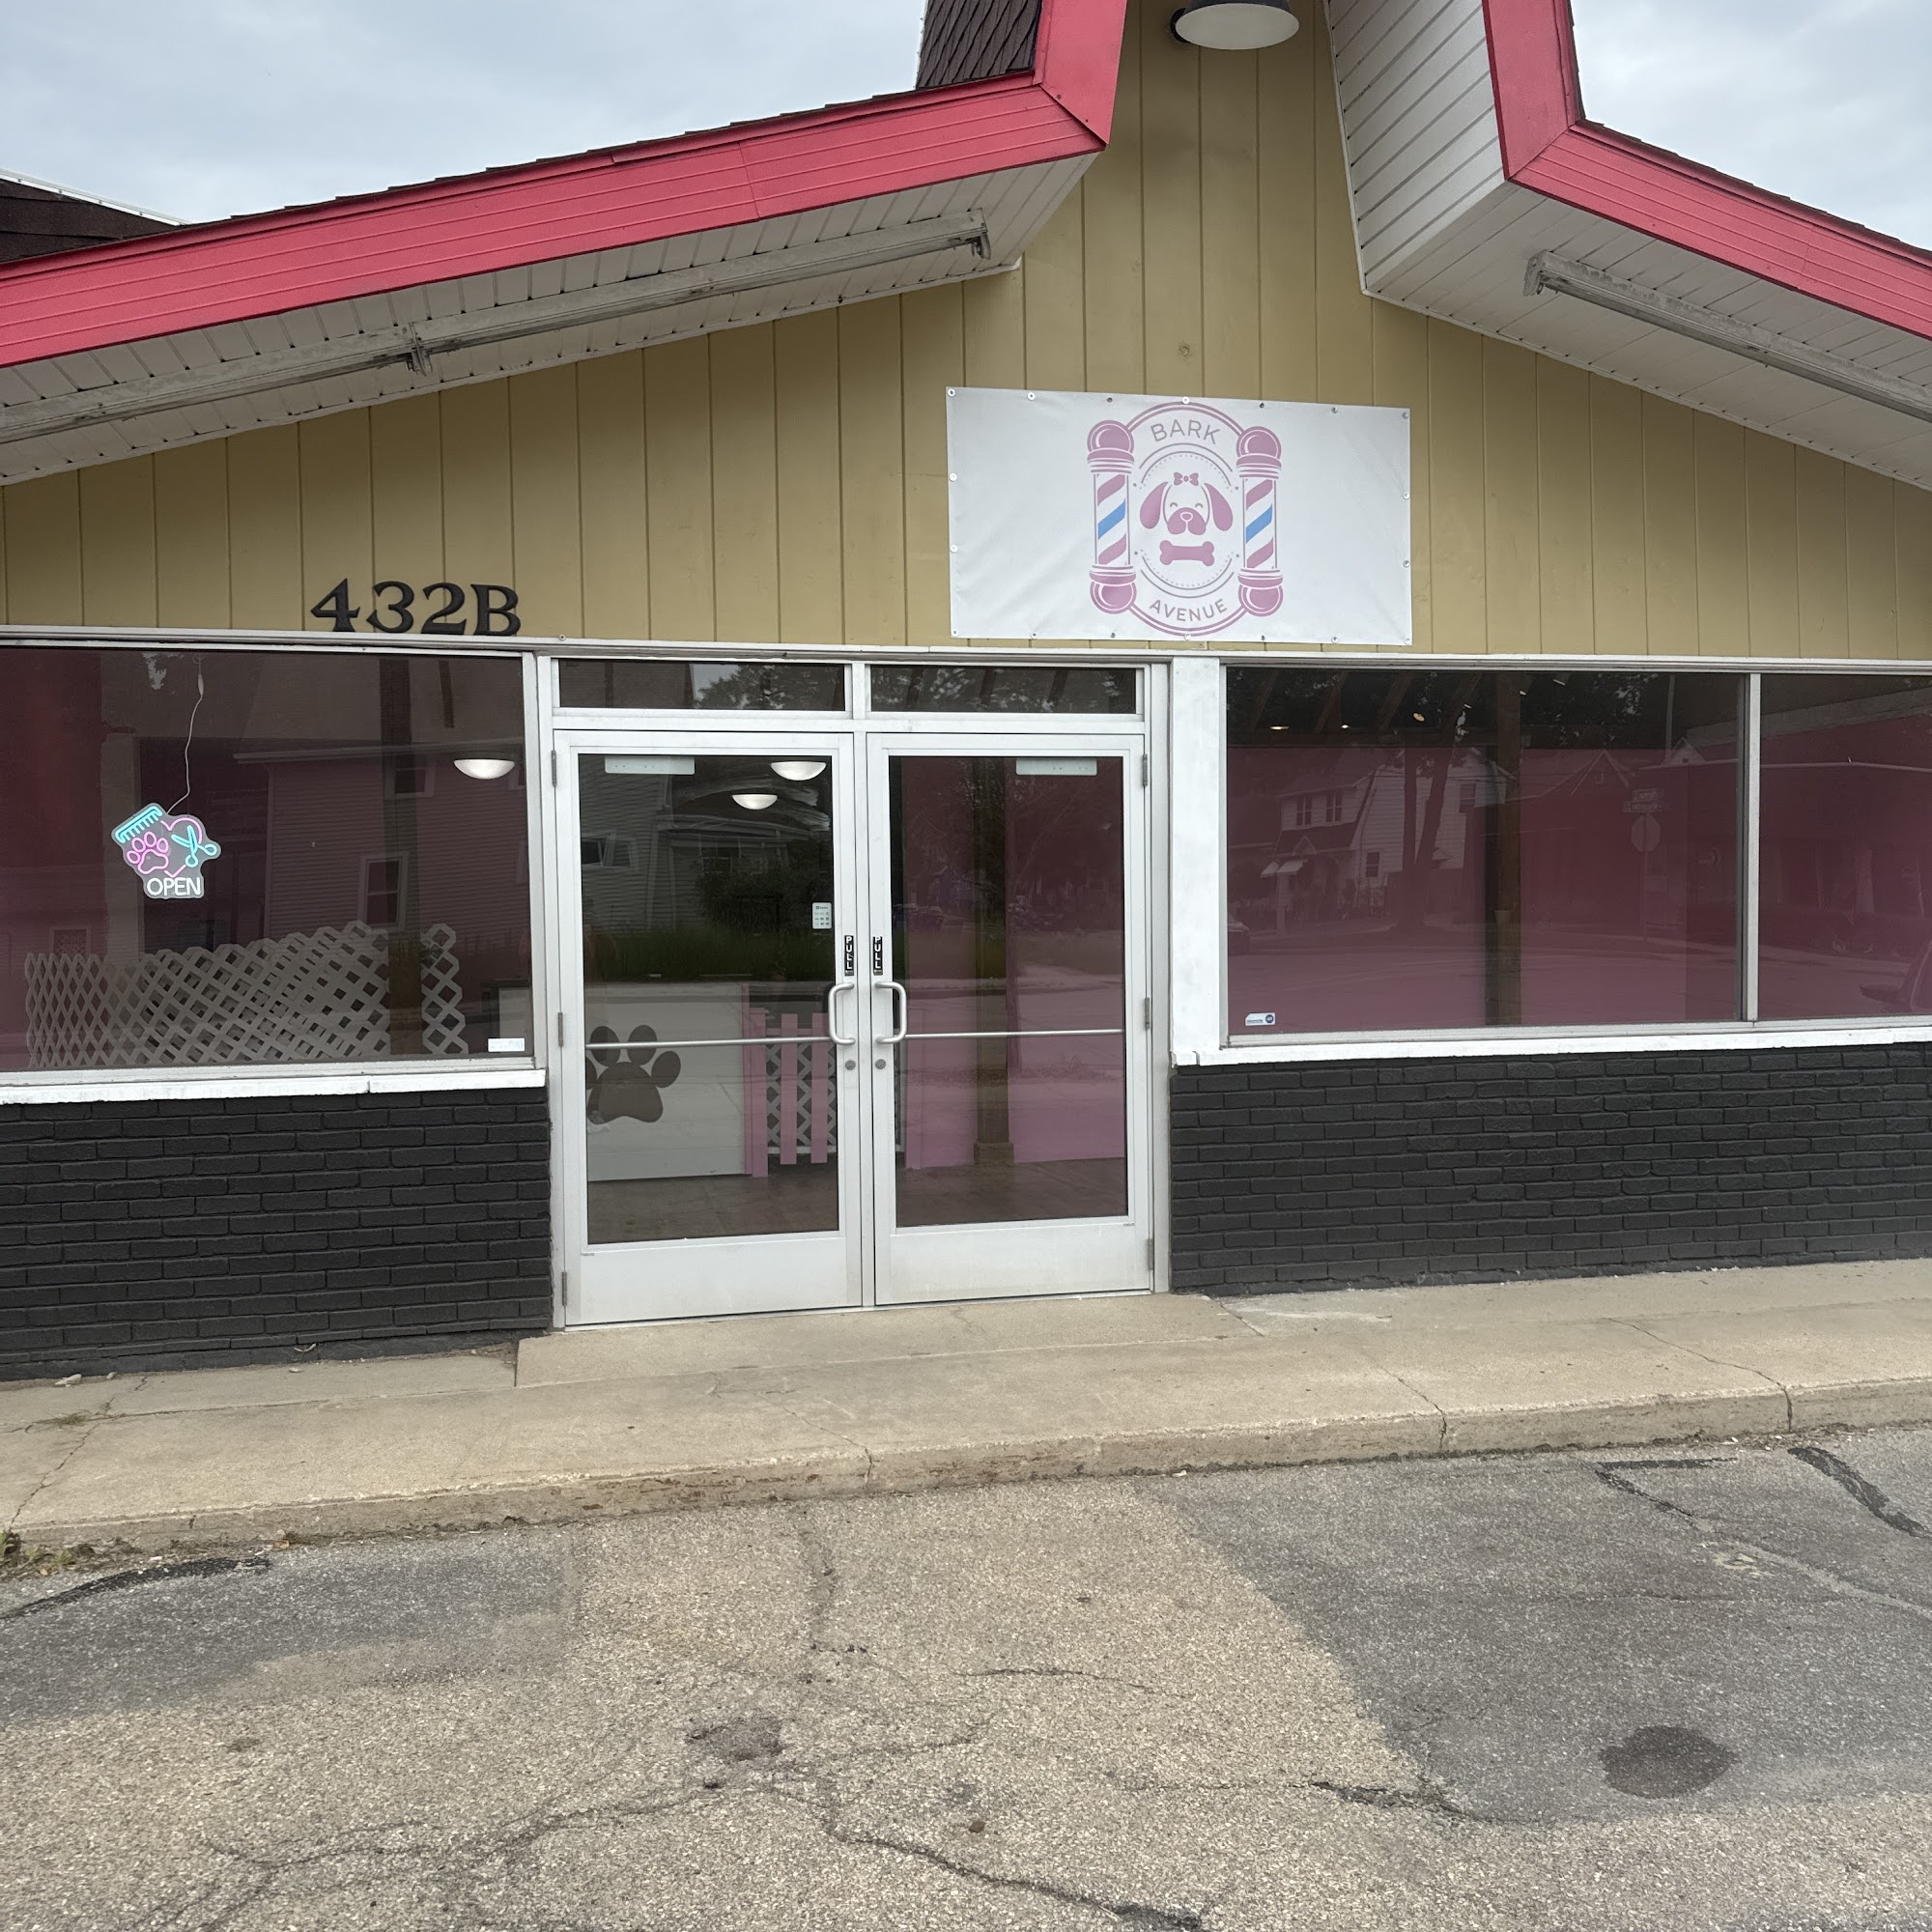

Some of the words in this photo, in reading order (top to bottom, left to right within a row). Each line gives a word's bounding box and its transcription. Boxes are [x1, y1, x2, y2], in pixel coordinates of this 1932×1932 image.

[1151, 419, 1220, 444] BARK
[310, 578, 521, 636] 432B
[1150, 599, 1227, 621] AVENUE
[147, 877, 201, 895] OPEN
